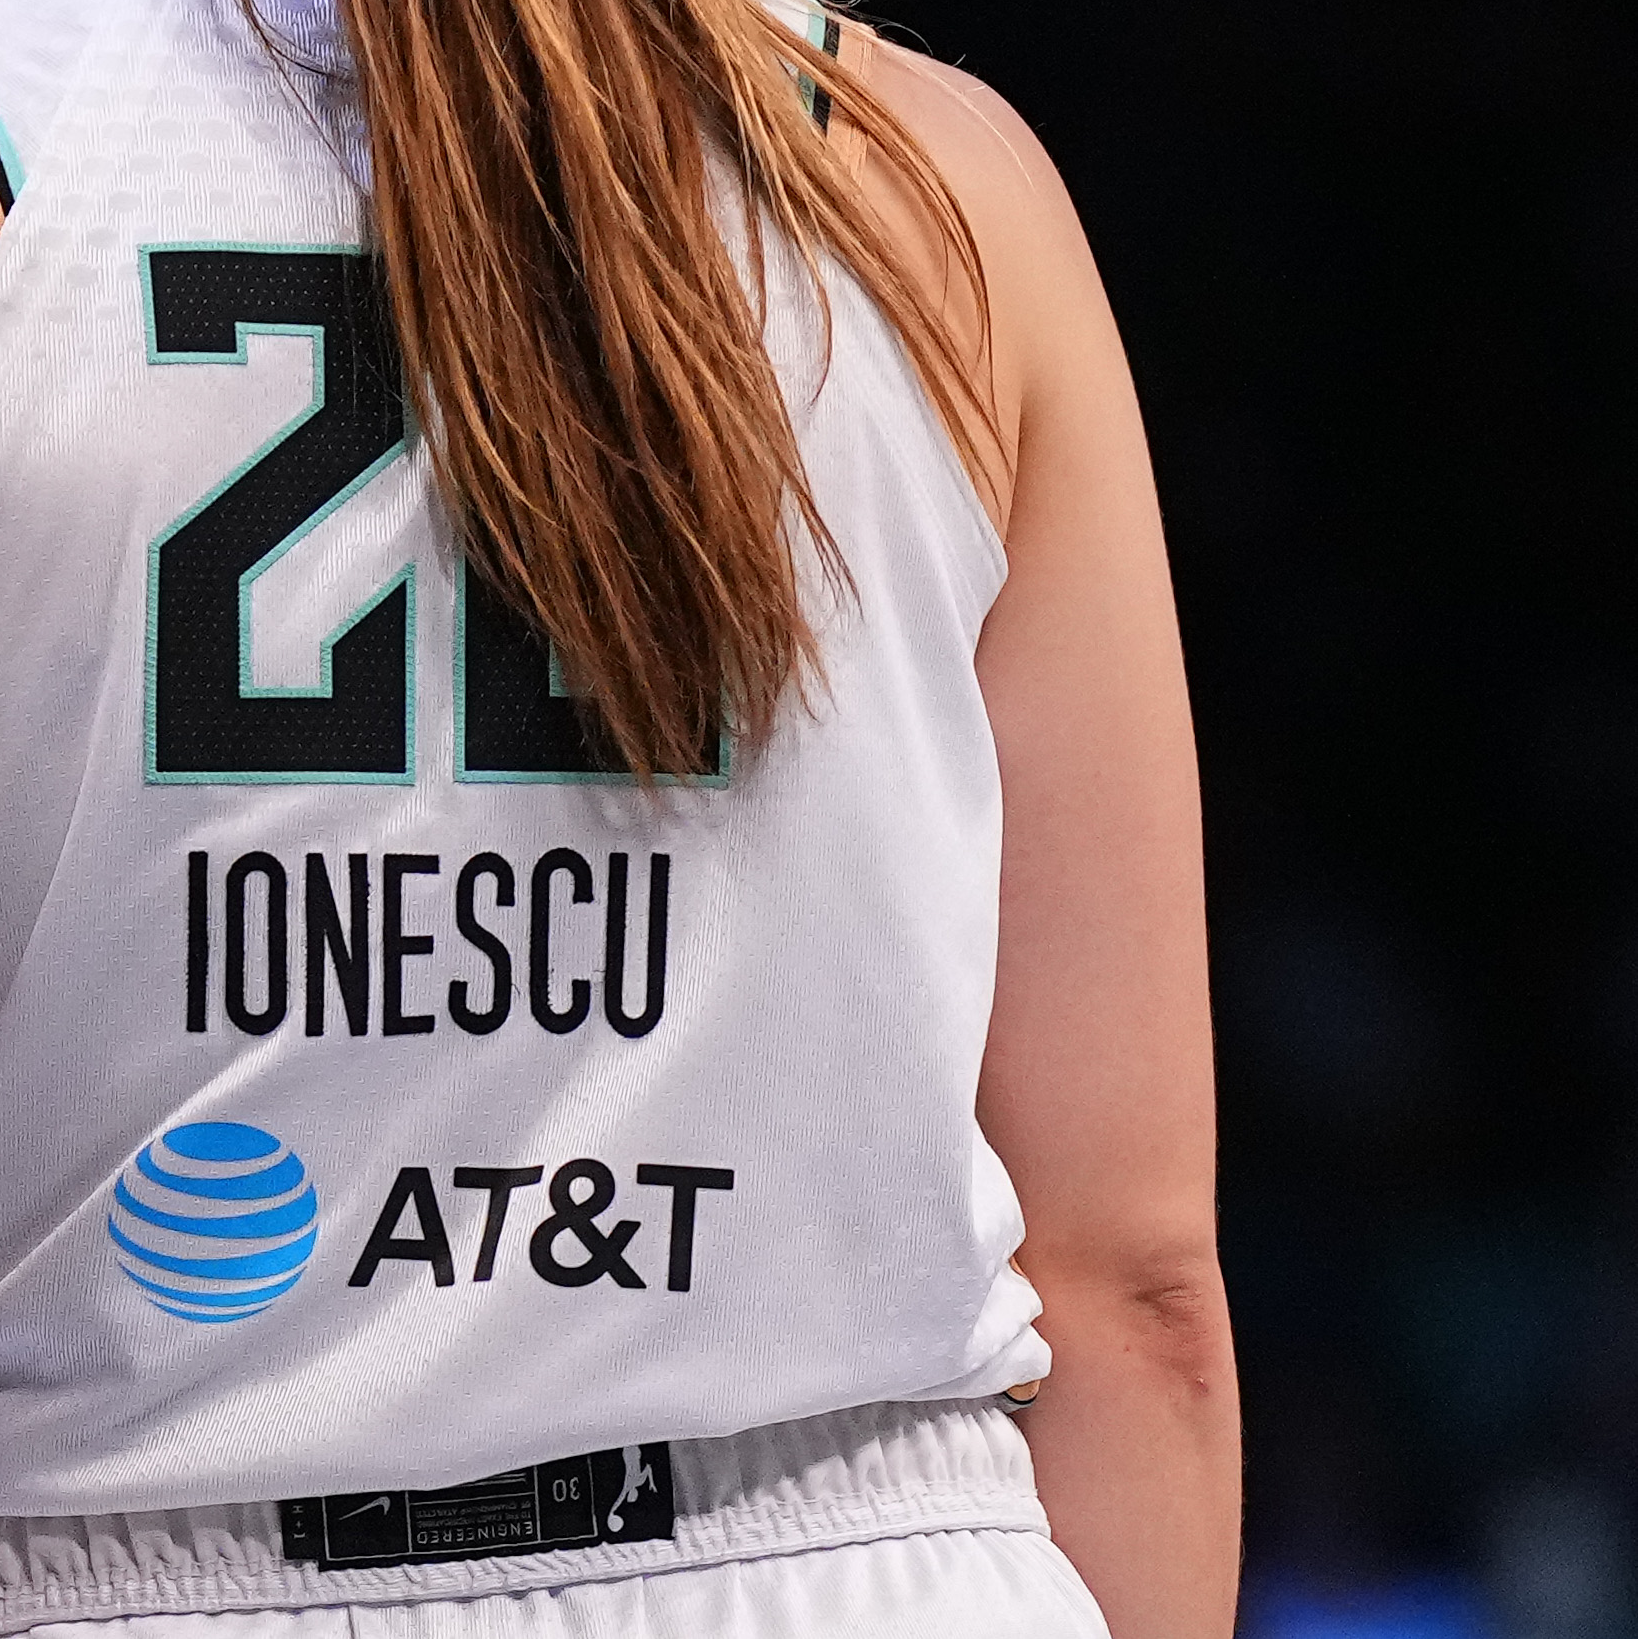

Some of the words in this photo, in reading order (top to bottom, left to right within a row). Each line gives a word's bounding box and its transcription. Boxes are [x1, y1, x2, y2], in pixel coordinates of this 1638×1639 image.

[185, 847, 671, 1039] IONESCU
[347, 1158, 735, 1293] AT&T
[552, 1476, 581, 1503] 30
[416, 1521, 534, 1545] ENGINEERED
